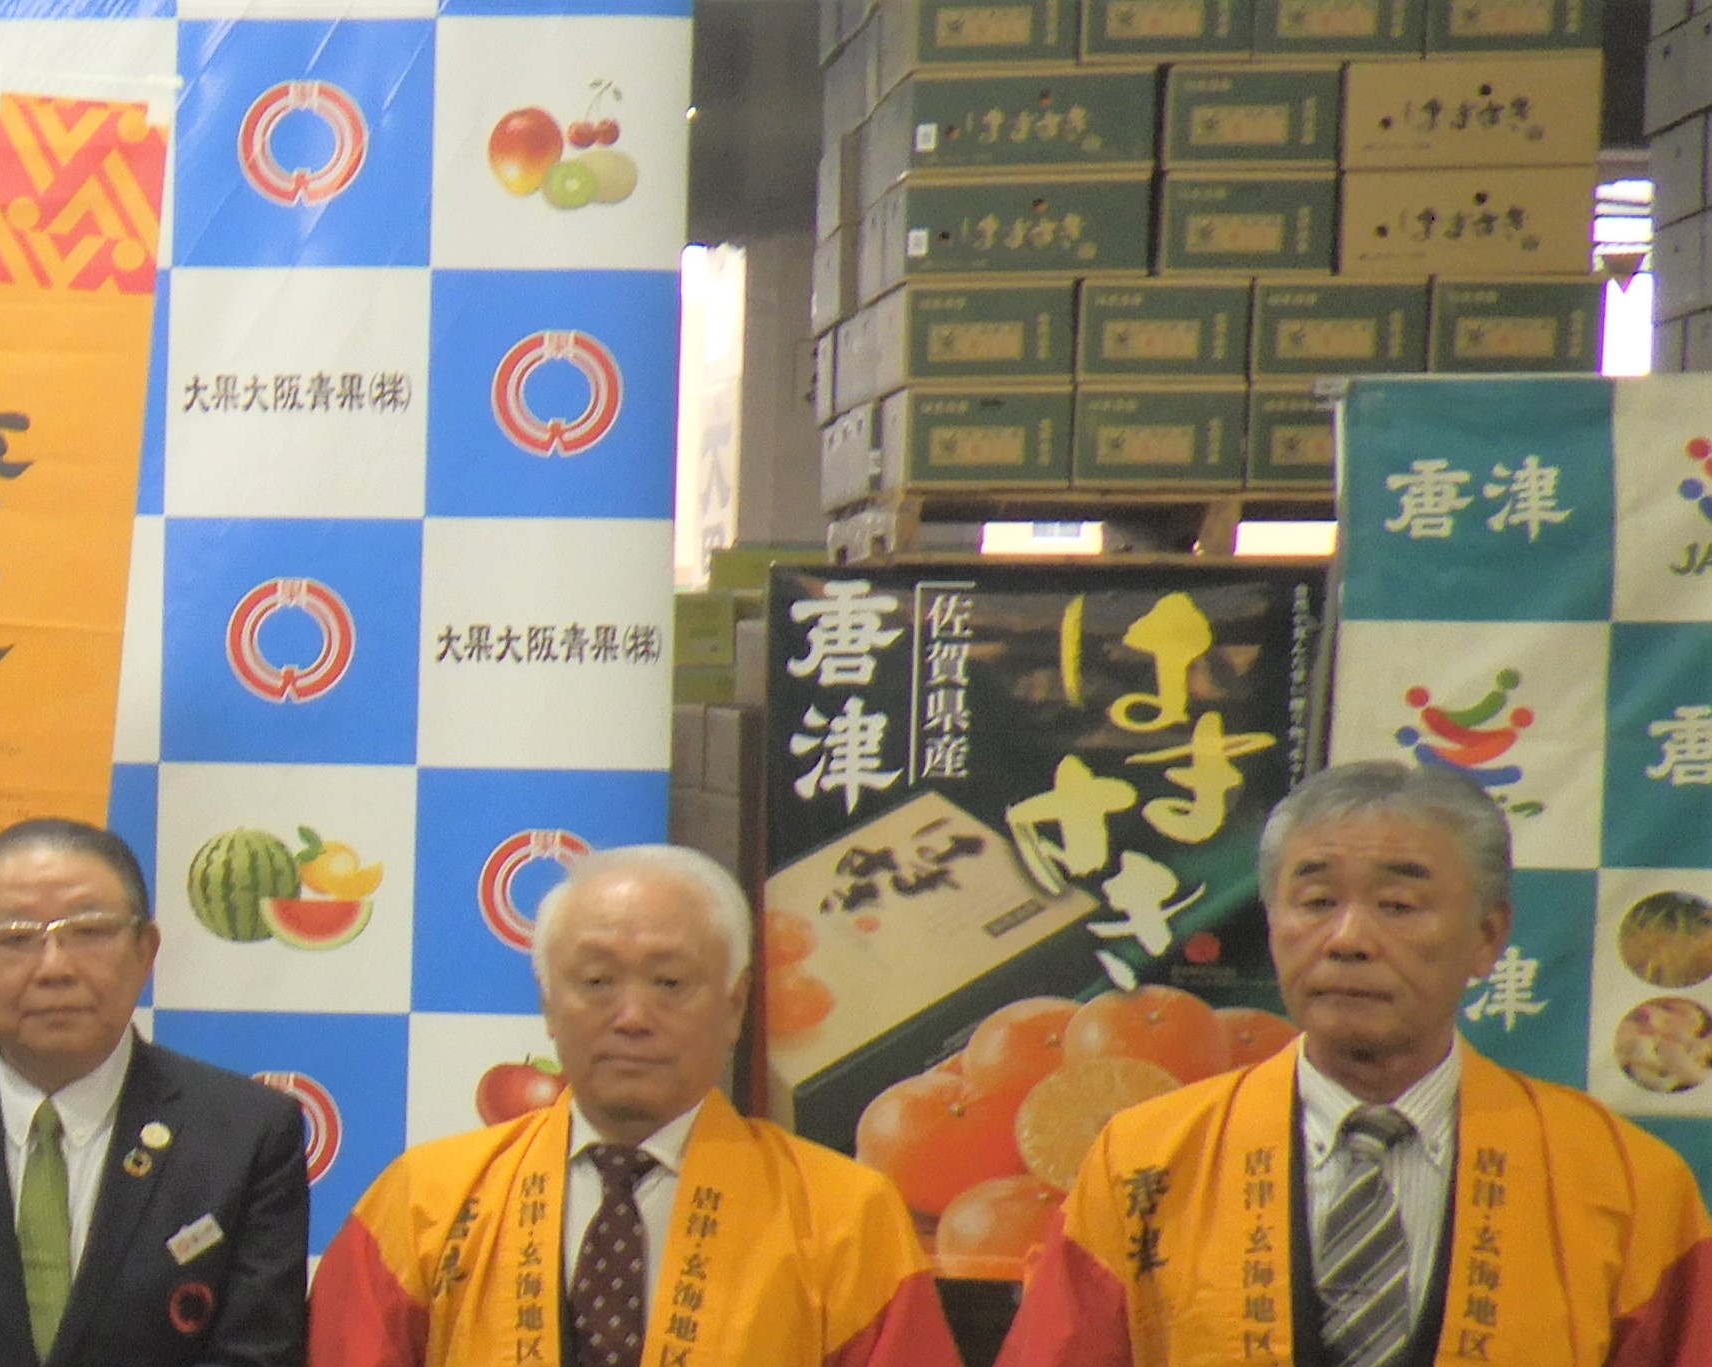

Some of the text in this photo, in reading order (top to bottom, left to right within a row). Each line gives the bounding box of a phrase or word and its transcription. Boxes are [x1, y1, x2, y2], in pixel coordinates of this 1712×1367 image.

[1383, 454, 1573, 542] 唐津
[787, 579, 907, 816] 唐津
[921, 592, 977, 781] 佐賀県産
